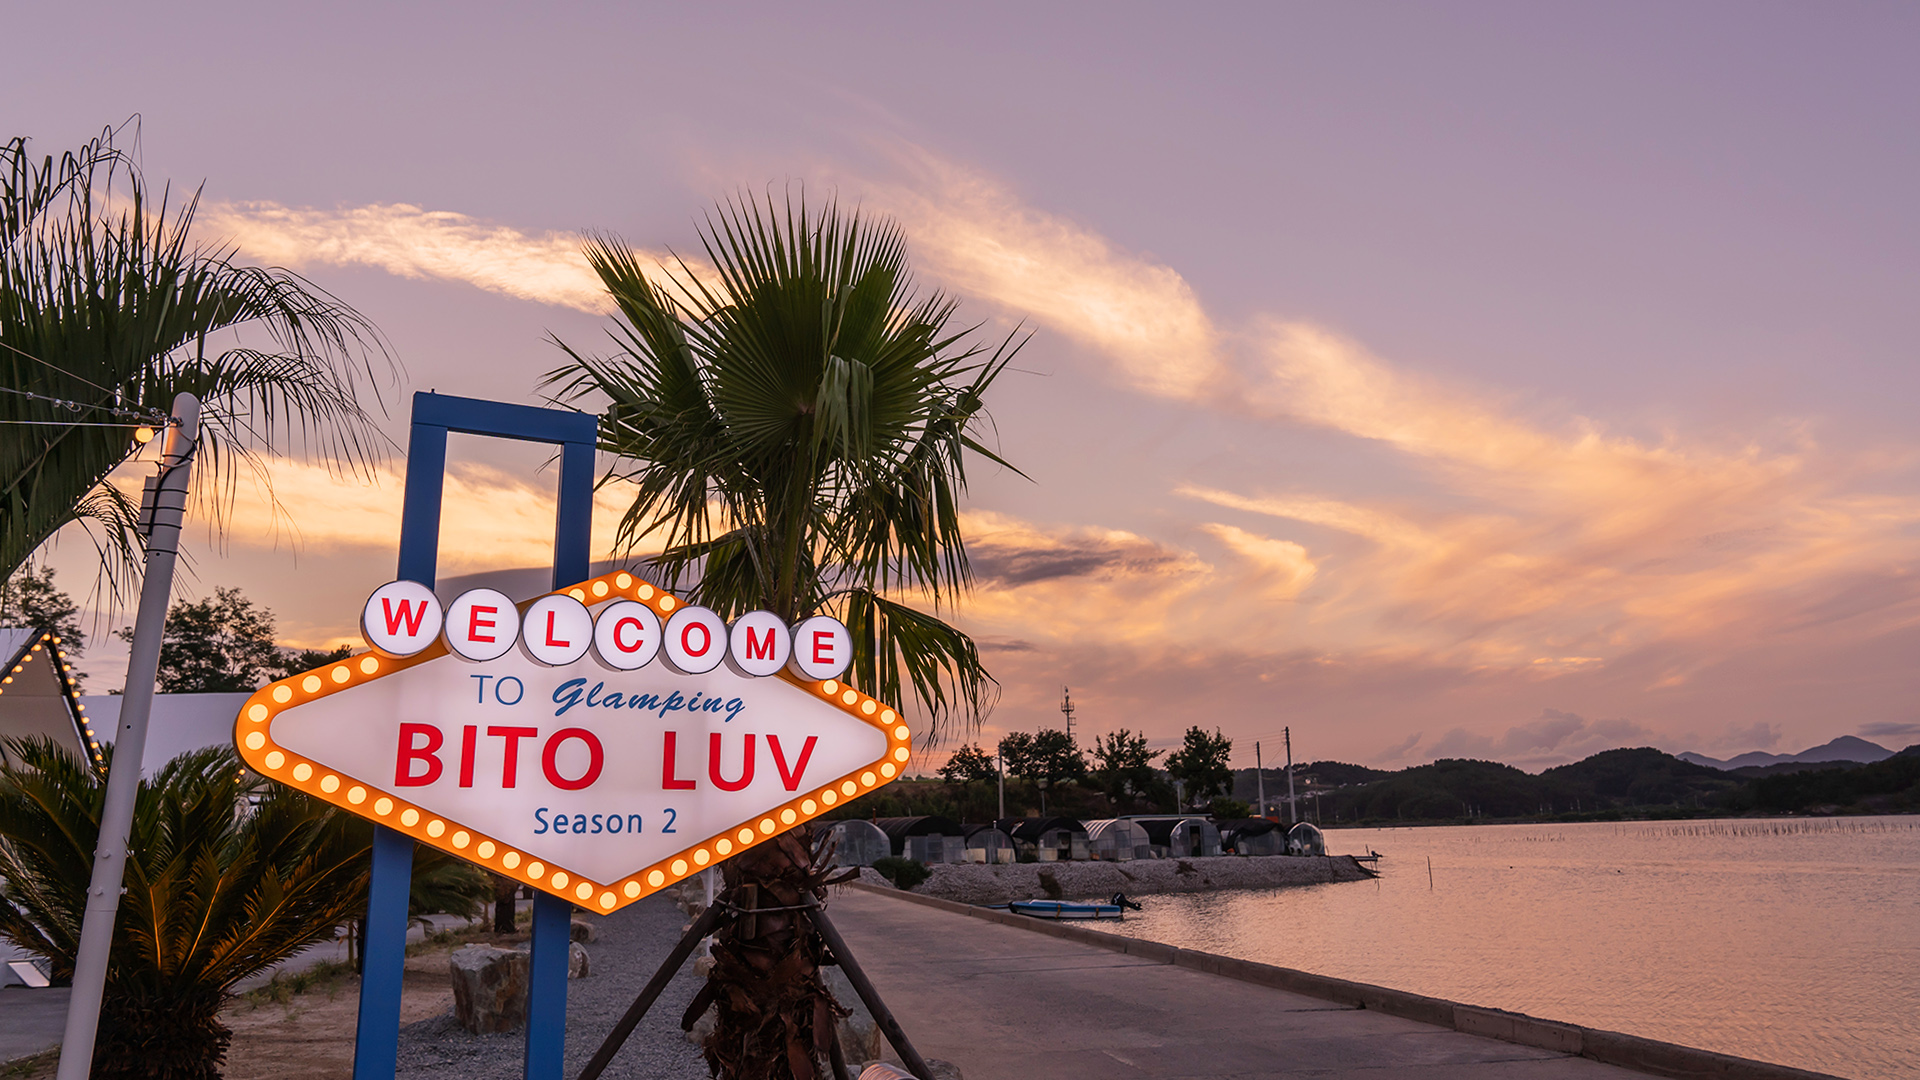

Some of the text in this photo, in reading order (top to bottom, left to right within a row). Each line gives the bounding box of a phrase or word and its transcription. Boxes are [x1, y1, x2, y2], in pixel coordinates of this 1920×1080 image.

[381, 597, 835, 665] WELCOME
[470, 674, 746, 723] TO Glamping
[394, 722, 819, 792] BITO LUV
[533, 807, 677, 835] Season 2
